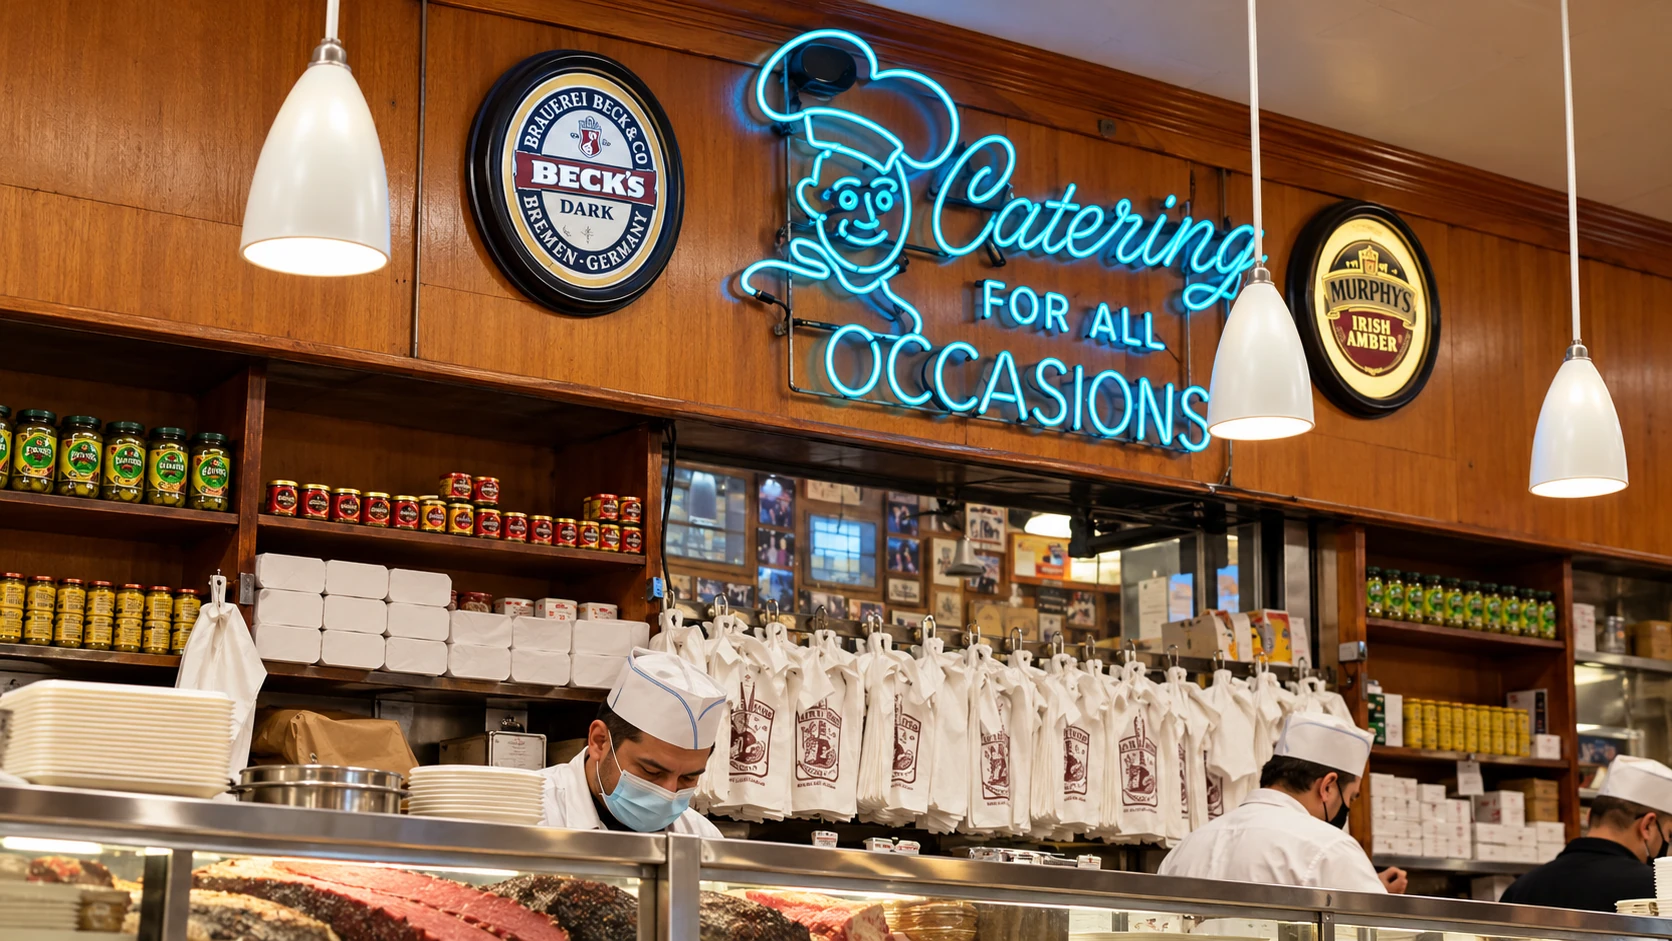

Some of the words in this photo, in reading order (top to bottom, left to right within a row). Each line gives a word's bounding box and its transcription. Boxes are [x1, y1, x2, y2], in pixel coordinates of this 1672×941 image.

[524, 91, 588, 150] BRAUEREI
[593, 94, 630, 130] BECK
[625, 126, 638, 142] &
[632, 140, 648, 165] CO
[531, 159, 645, 199] BECK'S
[523, 195, 577, 266] BREMEN
[586, 210, 648, 271] GERMANY
[559, 198, 614, 221] DARK
[932, 134, 1268, 311] Catering
[982, 279, 1070, 333] FOR
[1089, 302, 1166, 351] ALL
[1330, 278, 1413, 314] MURPHY'S
[1346, 330, 1398, 353] AMBER
[1352, 315, 1391, 334] IRISH
[825, 323, 1212, 453] OCCASIONS
